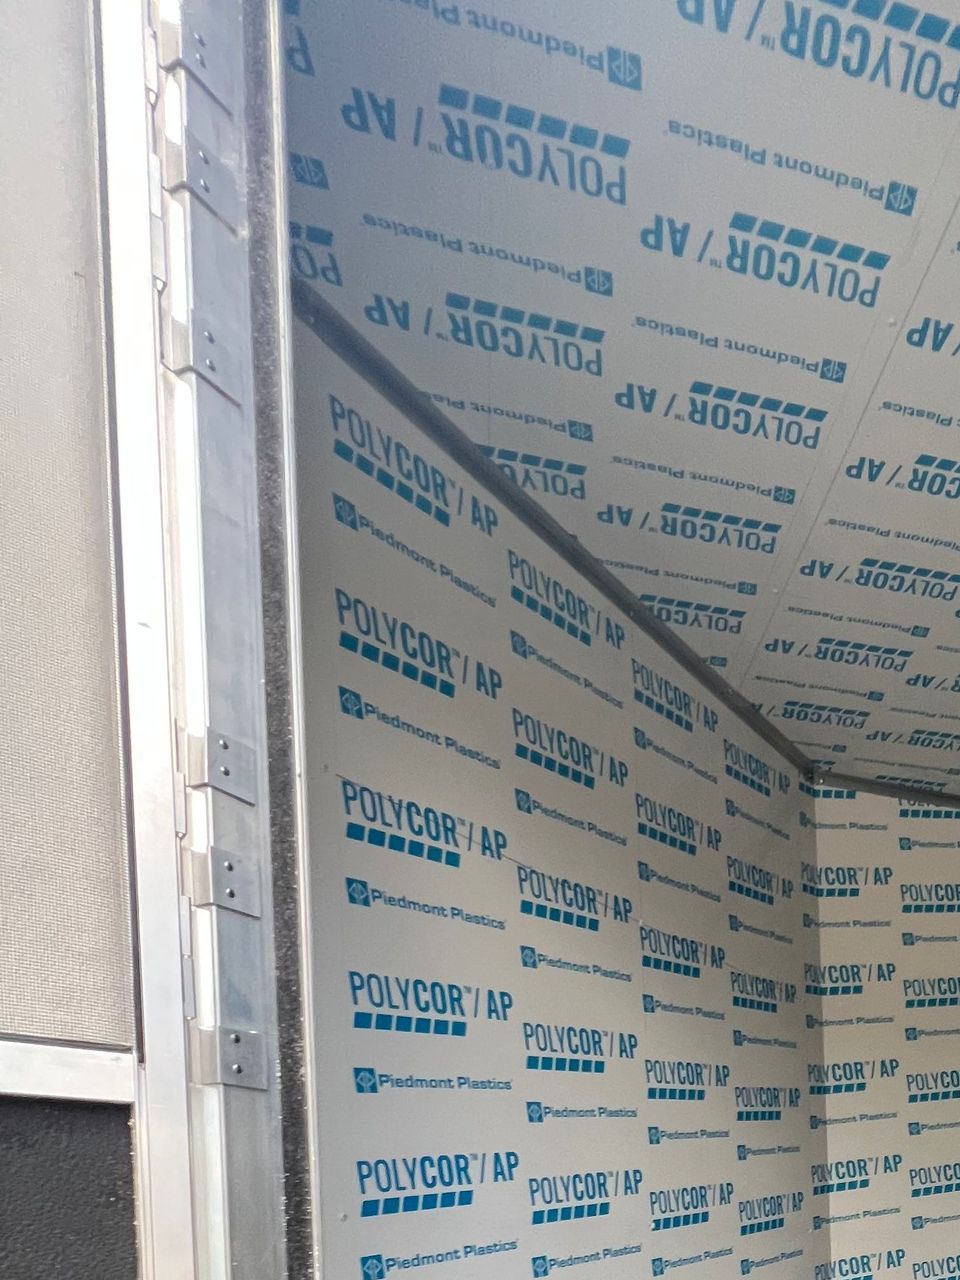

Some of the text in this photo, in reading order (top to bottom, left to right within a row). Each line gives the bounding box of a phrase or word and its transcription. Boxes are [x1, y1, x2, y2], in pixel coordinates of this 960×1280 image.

[676, 0, 735, 33] AP
[340, 86, 396, 141] AP
[666, 119, 884, 201] Piedmont Plastics
[361, 213, 581, 284] Piedmont Plastics
[638, 213, 691, 257] AP
[363, 293, 410, 331] AP
[634, 316, 819, 373] Piedmont Plastics
[904, 316, 955, 352] AP
[613, 382, 658, 413] AP
[471, 495, 498, 538] AP
[358, 513, 496, 608] Piedmont Plastics
[798, 559, 835, 579] AP
[475, 661, 502, 700] AP
[363, 701, 500, 769] Piedmont Plastics
[609, 755, 628, 787] AP
[531, 798, 586, 830] Piedmont
[480, 825, 507, 861] AP
[370, 887, 505, 930] Piedmont Plastics
[486, 989, 513, 1021] AP
[917, 1027, 960, 1036] Piedmont
[377, 1073, 512, 1089] Piedmont Plastics
[715, 1064, 729, 1087] AP
[659, 1129, 699, 1139] Piedmont
[493, 1151, 519, 1182] AP
[623, 1168, 642, 1195] AP
[792, 1191, 803, 1212] AP
[384, 1239, 517, 1271] Piedmont Plastics
[548, 1250, 601, 1269] Piedmont
